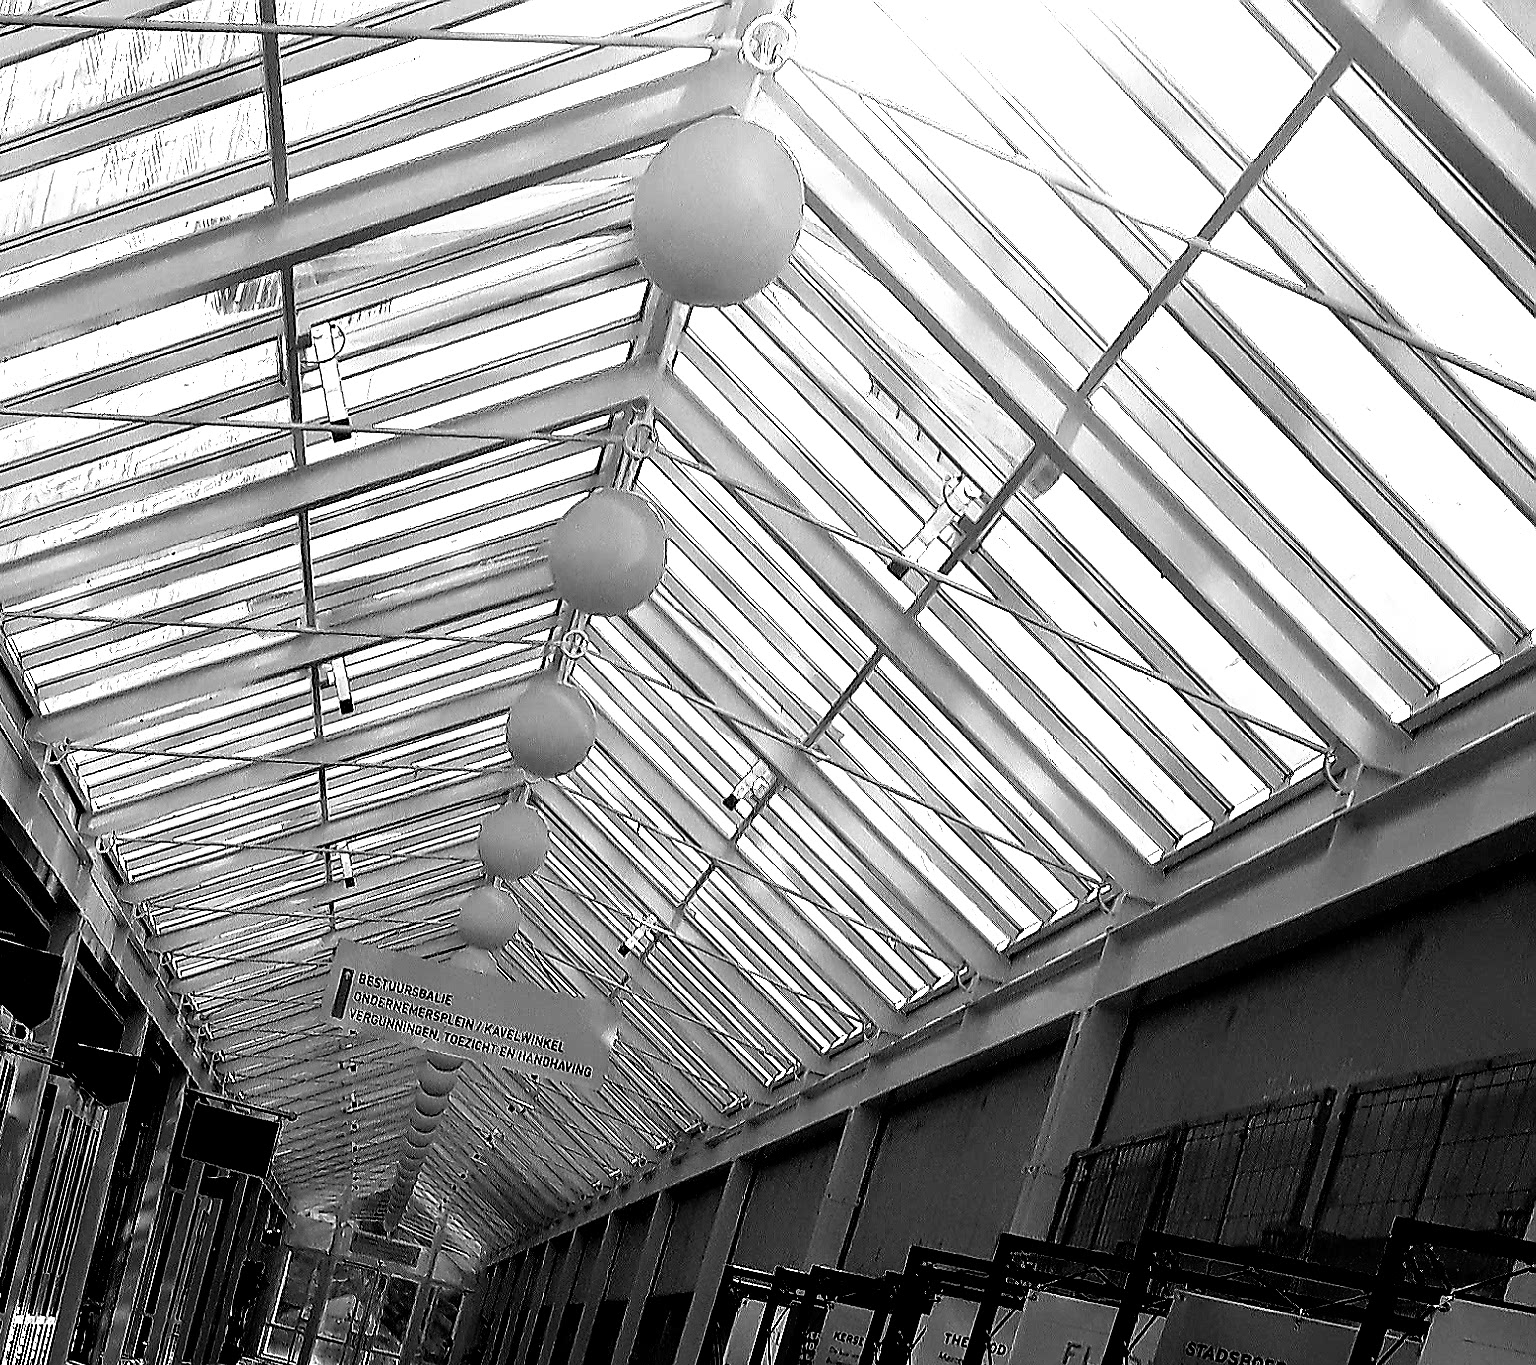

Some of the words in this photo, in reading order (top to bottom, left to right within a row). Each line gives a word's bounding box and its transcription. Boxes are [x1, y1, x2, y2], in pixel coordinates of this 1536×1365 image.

[358, 973, 454, 1006] BESTUURSBALIE
[349, 1008, 440, 1043] VERGUNNINGEN,
[444, 1031, 498, 1055] TOEZICHT
[499, 1043, 517, 1059] EN
[517, 1049, 593, 1079] HANDHAVING
[353, 991, 475, 1030] ONDERNEMERSPLEIN
[483, 1023, 565, 1053] KAVELWINKEL
